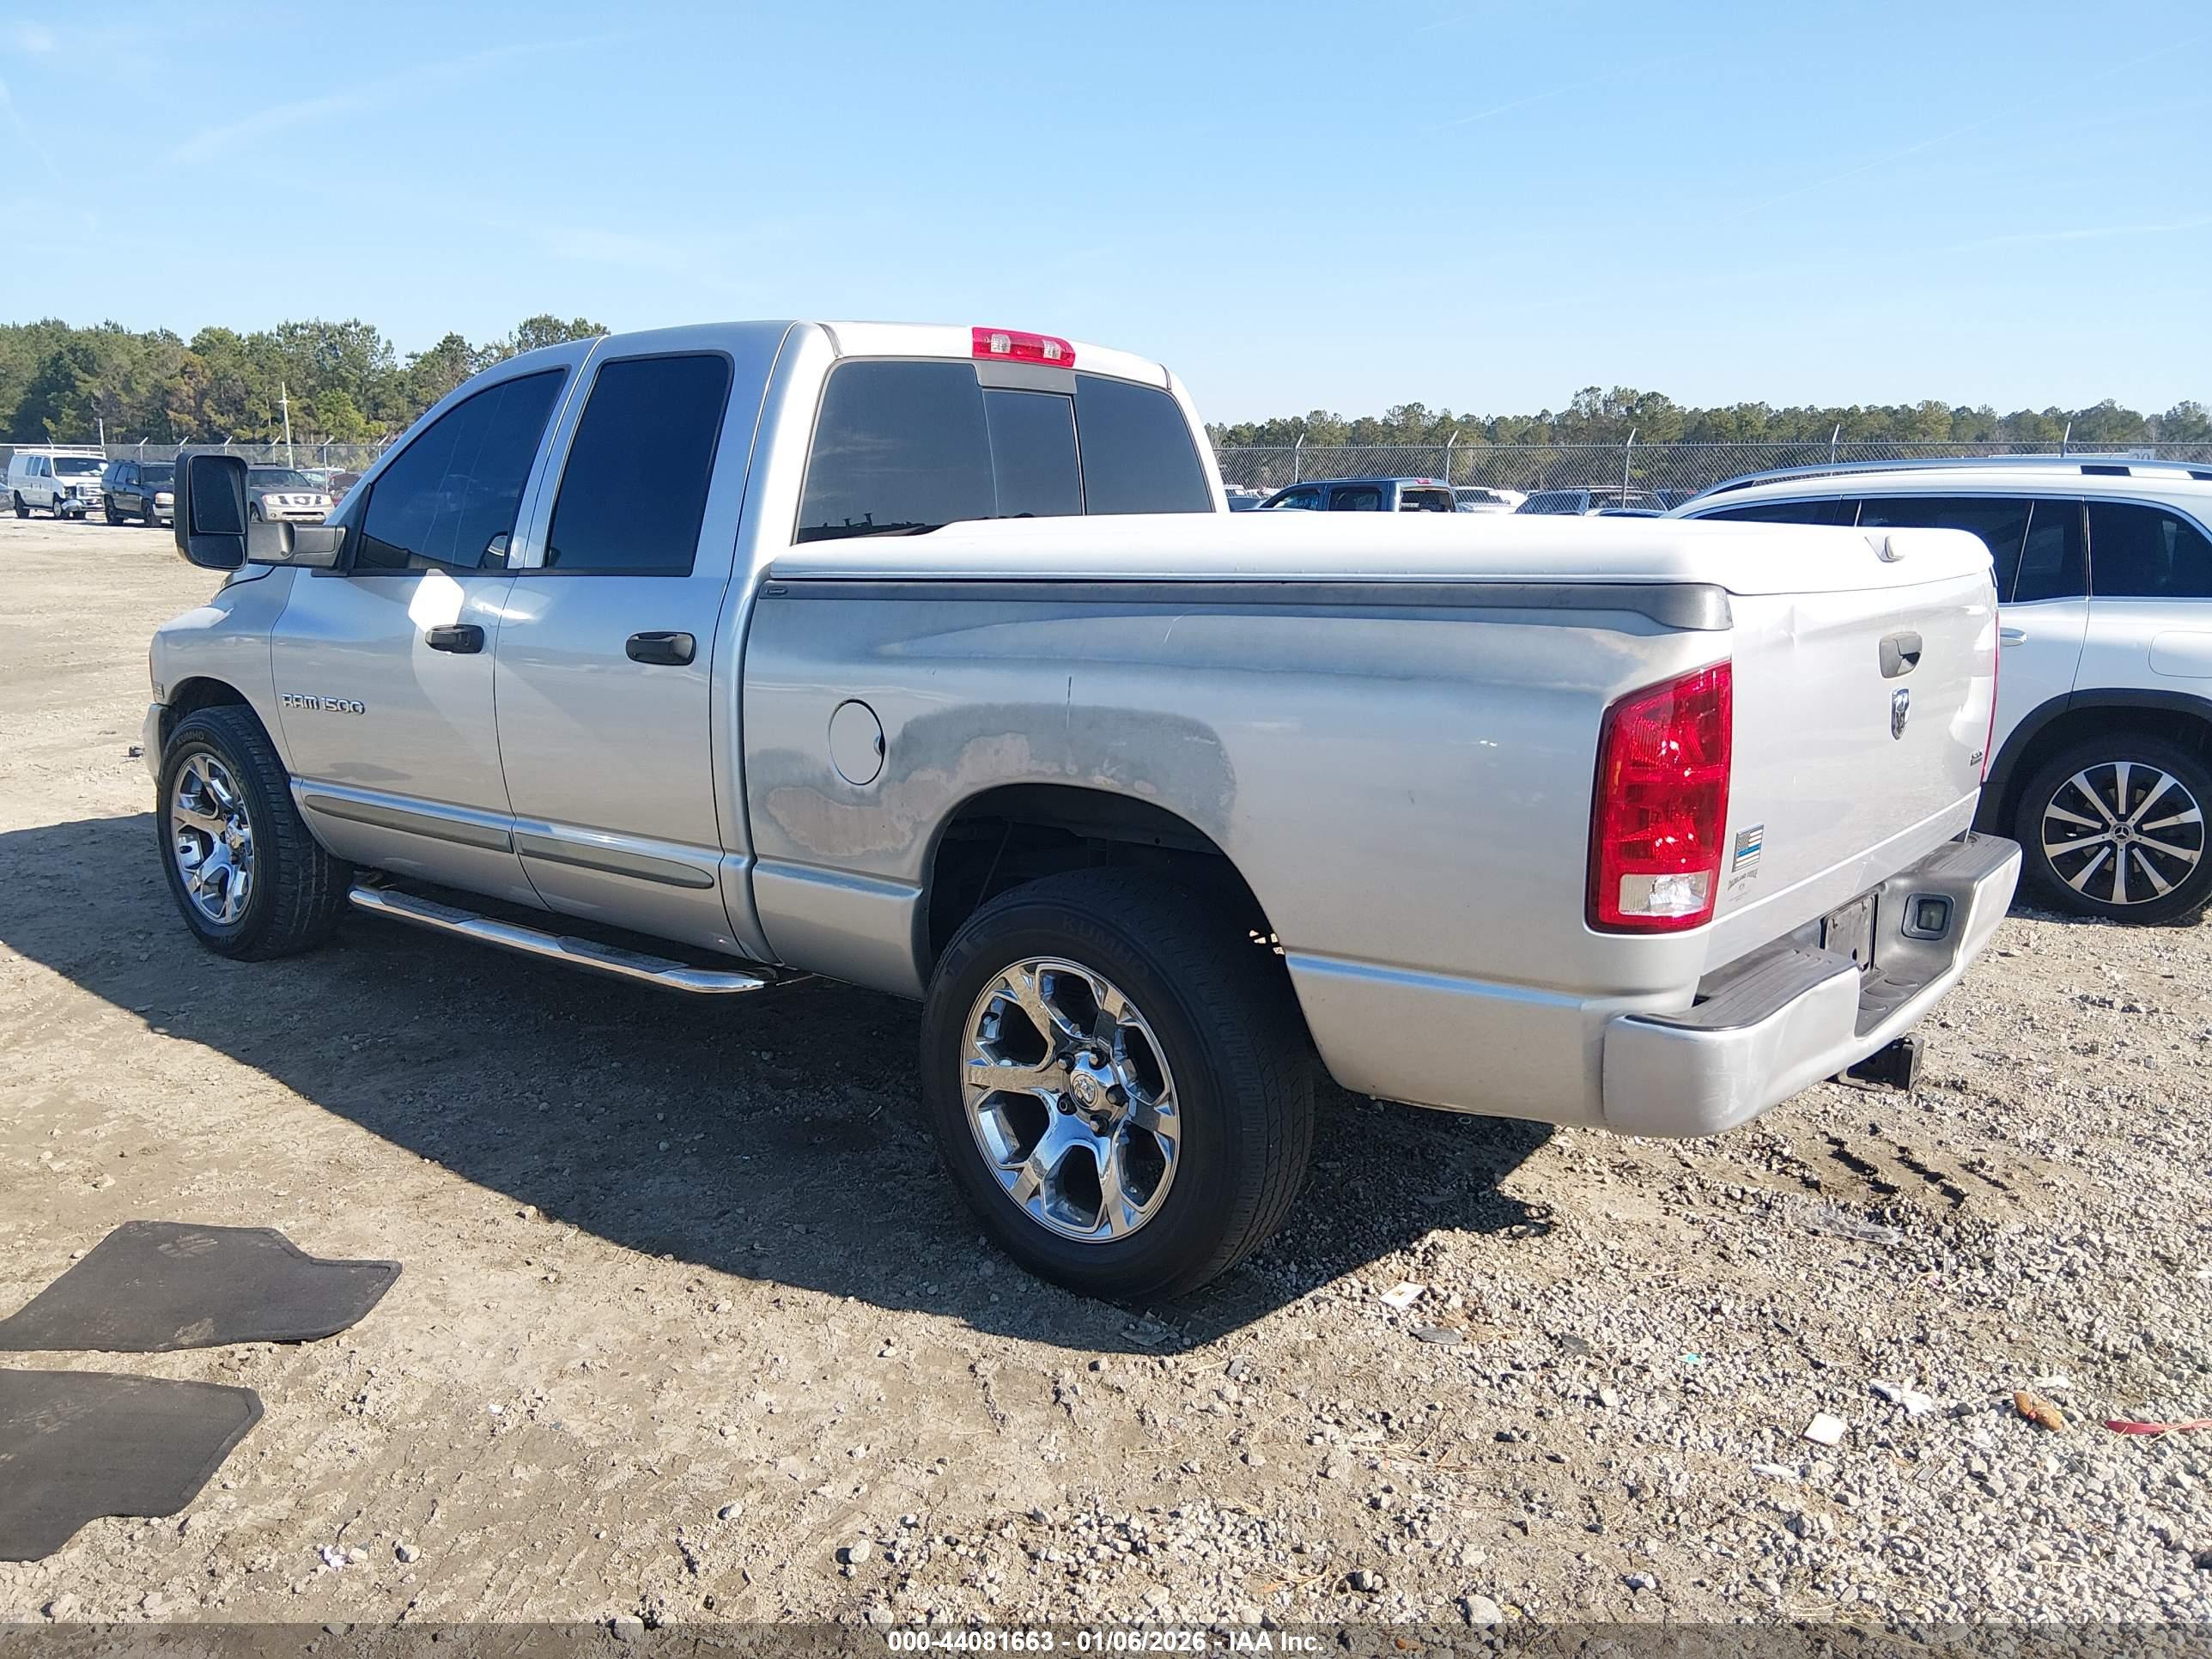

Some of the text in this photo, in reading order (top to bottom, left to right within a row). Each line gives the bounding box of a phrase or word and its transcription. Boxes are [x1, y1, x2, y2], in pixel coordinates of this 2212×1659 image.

[282, 693, 365, 714] RAM 1500
[176, 730, 204, 747] KUMHO
